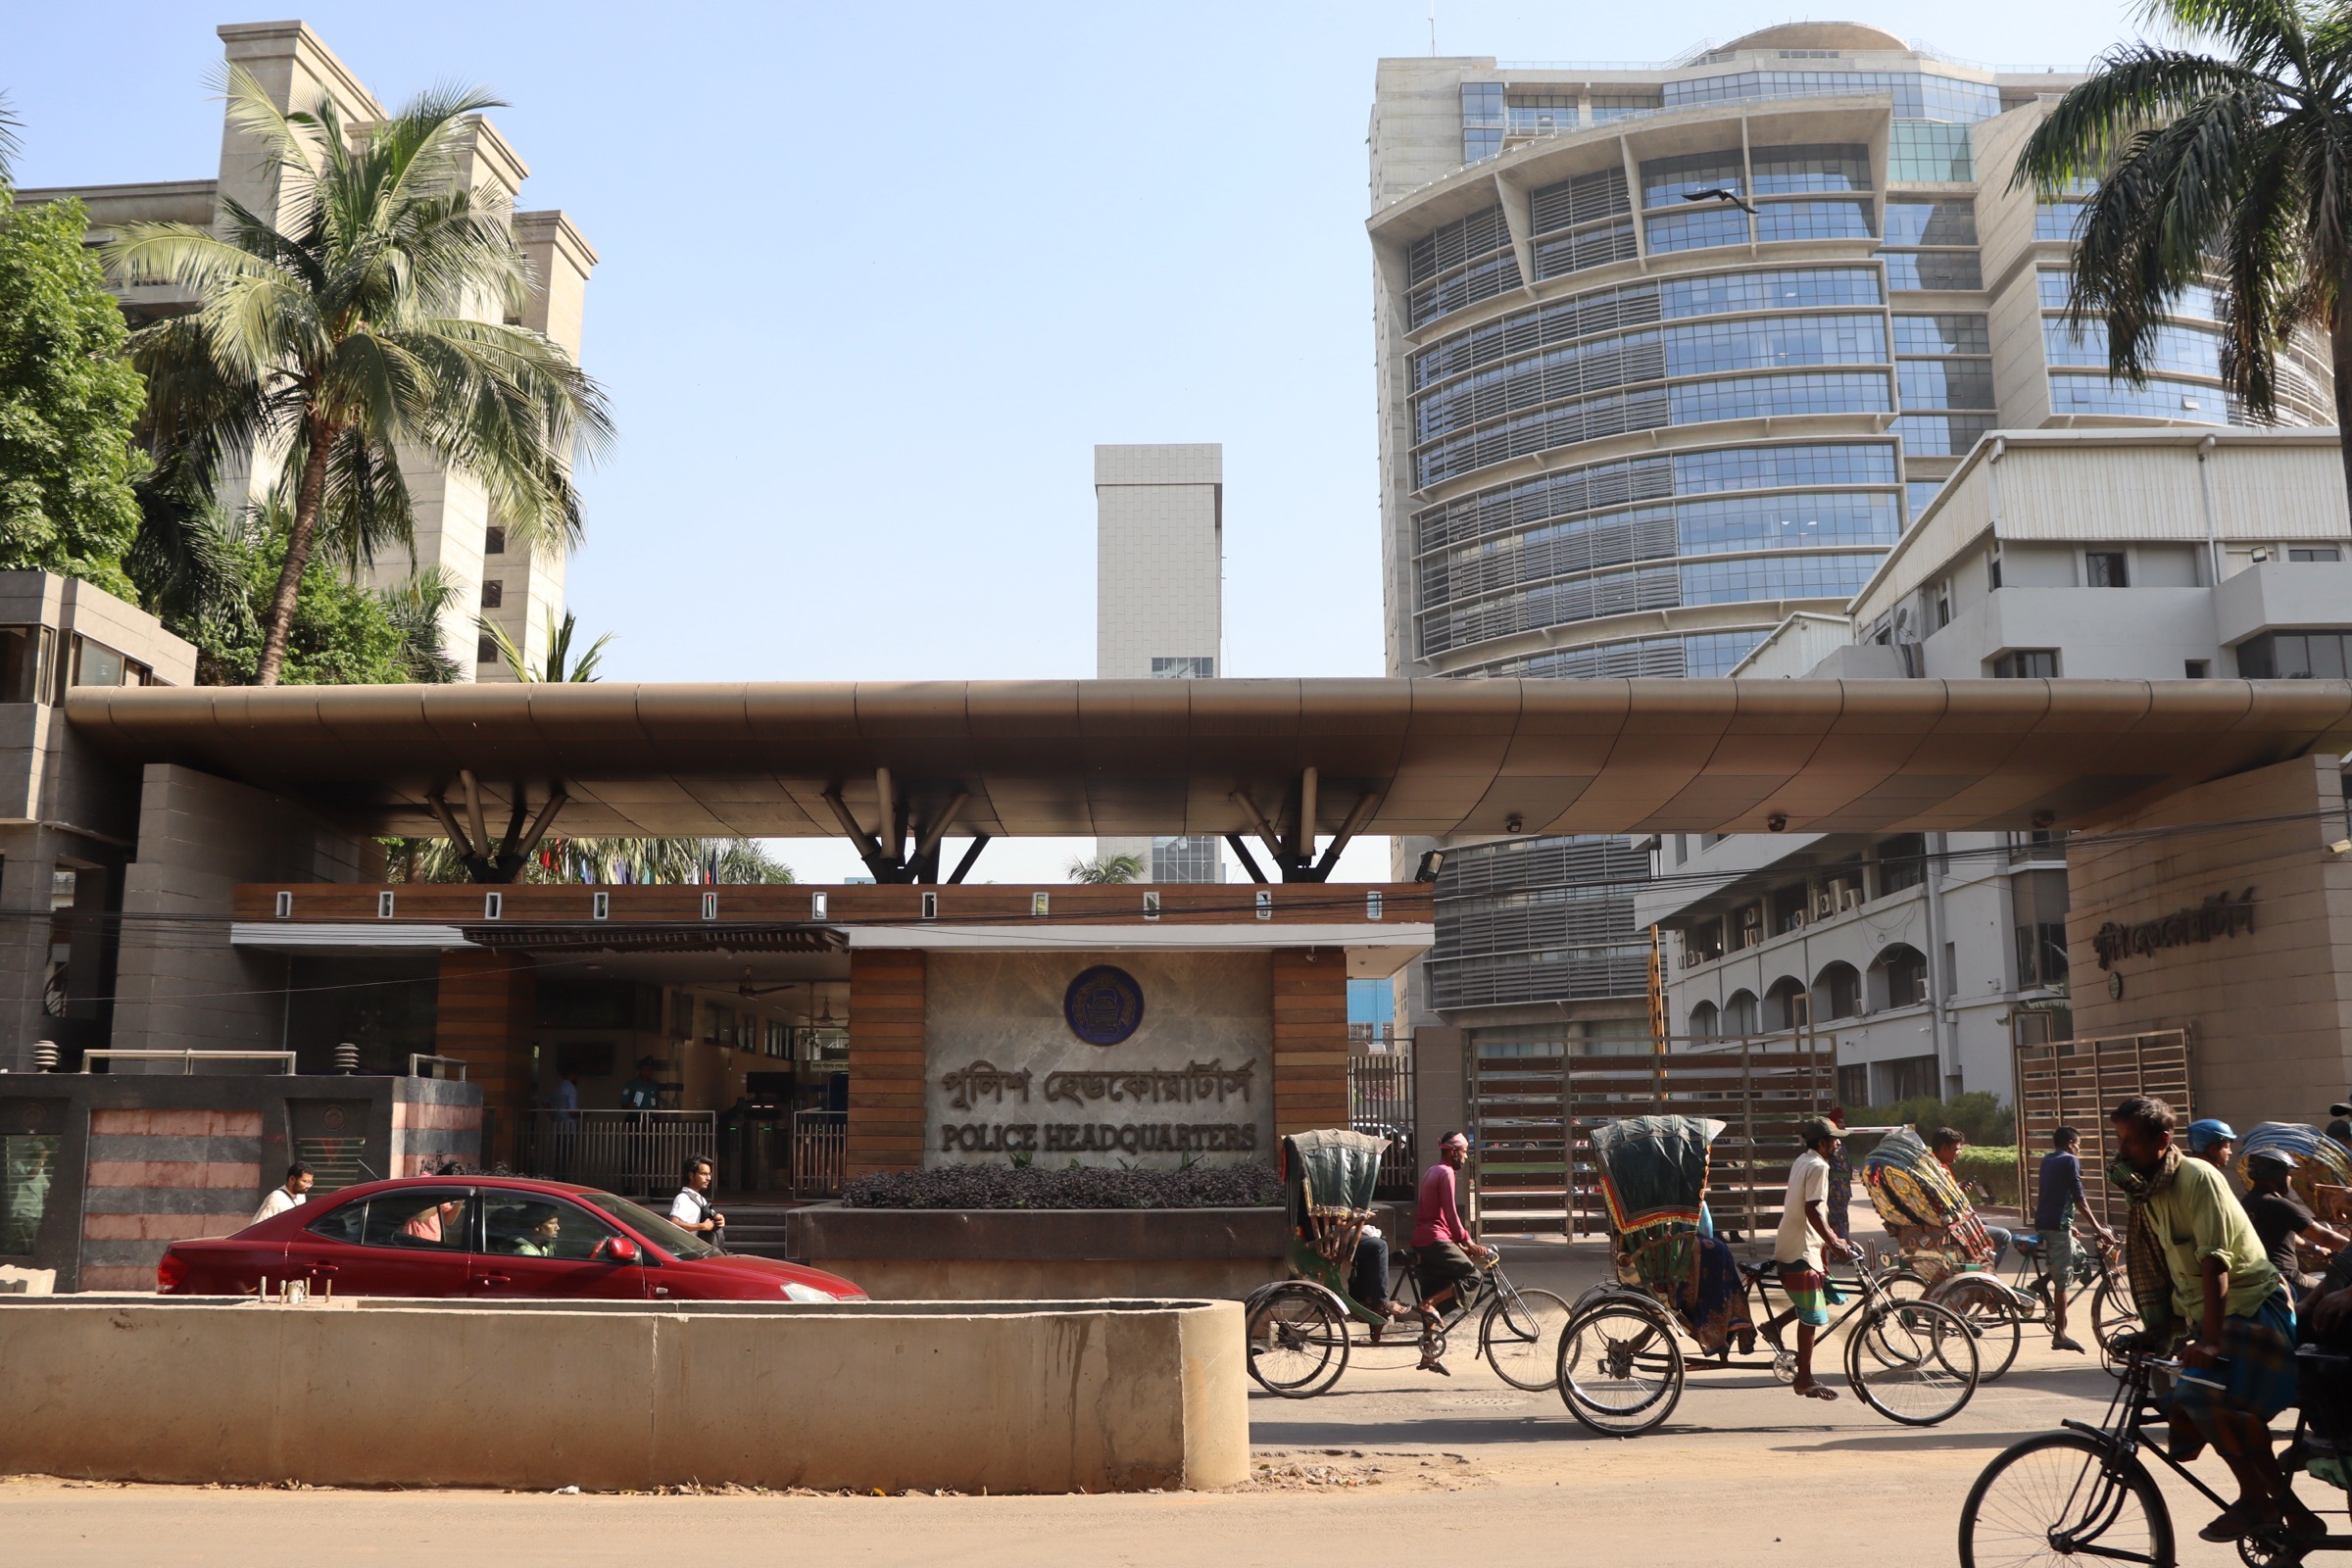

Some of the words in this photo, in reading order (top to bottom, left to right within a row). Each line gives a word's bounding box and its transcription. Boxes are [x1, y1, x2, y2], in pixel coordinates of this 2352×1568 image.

[942, 1060, 1033, 1109] পুলিশ
[942, 1123, 1038, 1152] POLICE
[1044, 1123, 1257, 1154] HEADQUARTERS
